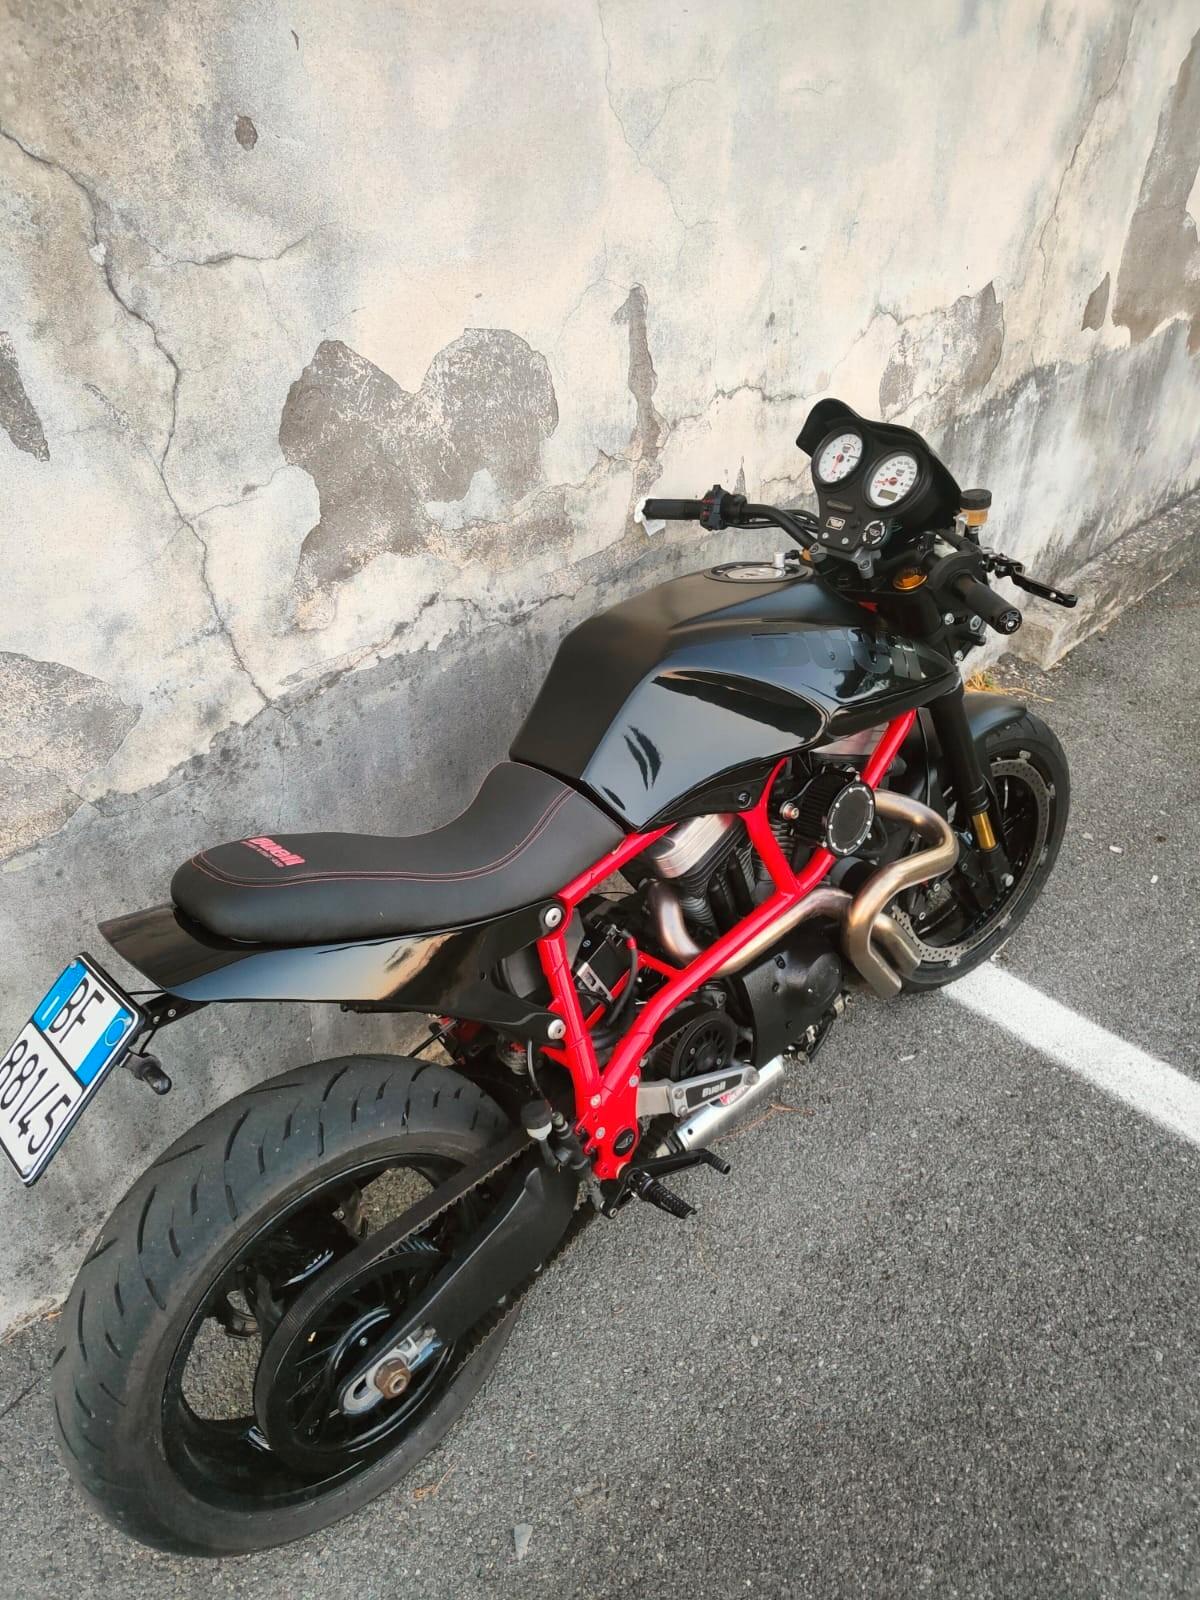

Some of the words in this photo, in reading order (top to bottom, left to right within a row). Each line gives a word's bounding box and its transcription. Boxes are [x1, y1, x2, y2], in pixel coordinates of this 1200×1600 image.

[48, 977, 105, 1044] BF
[0, 1039, 72, 1155] 88145
[702, 1081, 726, 1098] Buell
